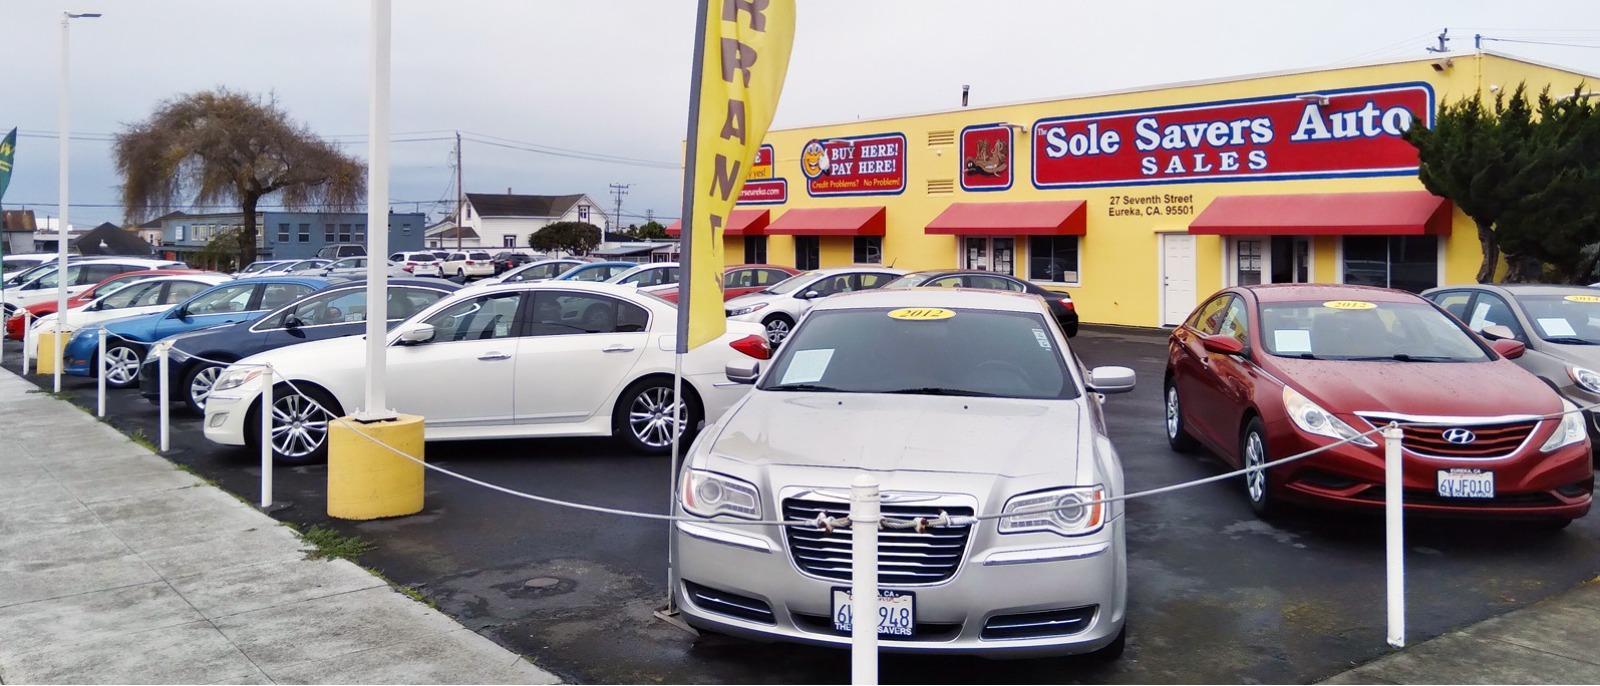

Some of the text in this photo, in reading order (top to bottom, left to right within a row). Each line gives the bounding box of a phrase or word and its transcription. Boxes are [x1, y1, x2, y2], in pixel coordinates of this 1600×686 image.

[1046, 122, 1120, 158] Sole
[1135, 117, 1273, 150] Savers
[1291, 102, 1412, 141] Auto
[831, 143, 898, 160] BUY HERE!
[831, 158, 896, 176] PAY HERE!
[1141, 150, 1267, 175] SALES
[812, 176, 900, 189] Credit Problems? No Problem!
[1110, 194, 1193, 205] 27 Seventh Street
[1108, 205, 1194, 217] Eureka, CA. 95501
[898, 308, 944, 318] 2012
[834, 622, 912, 636] THE SAVERS
